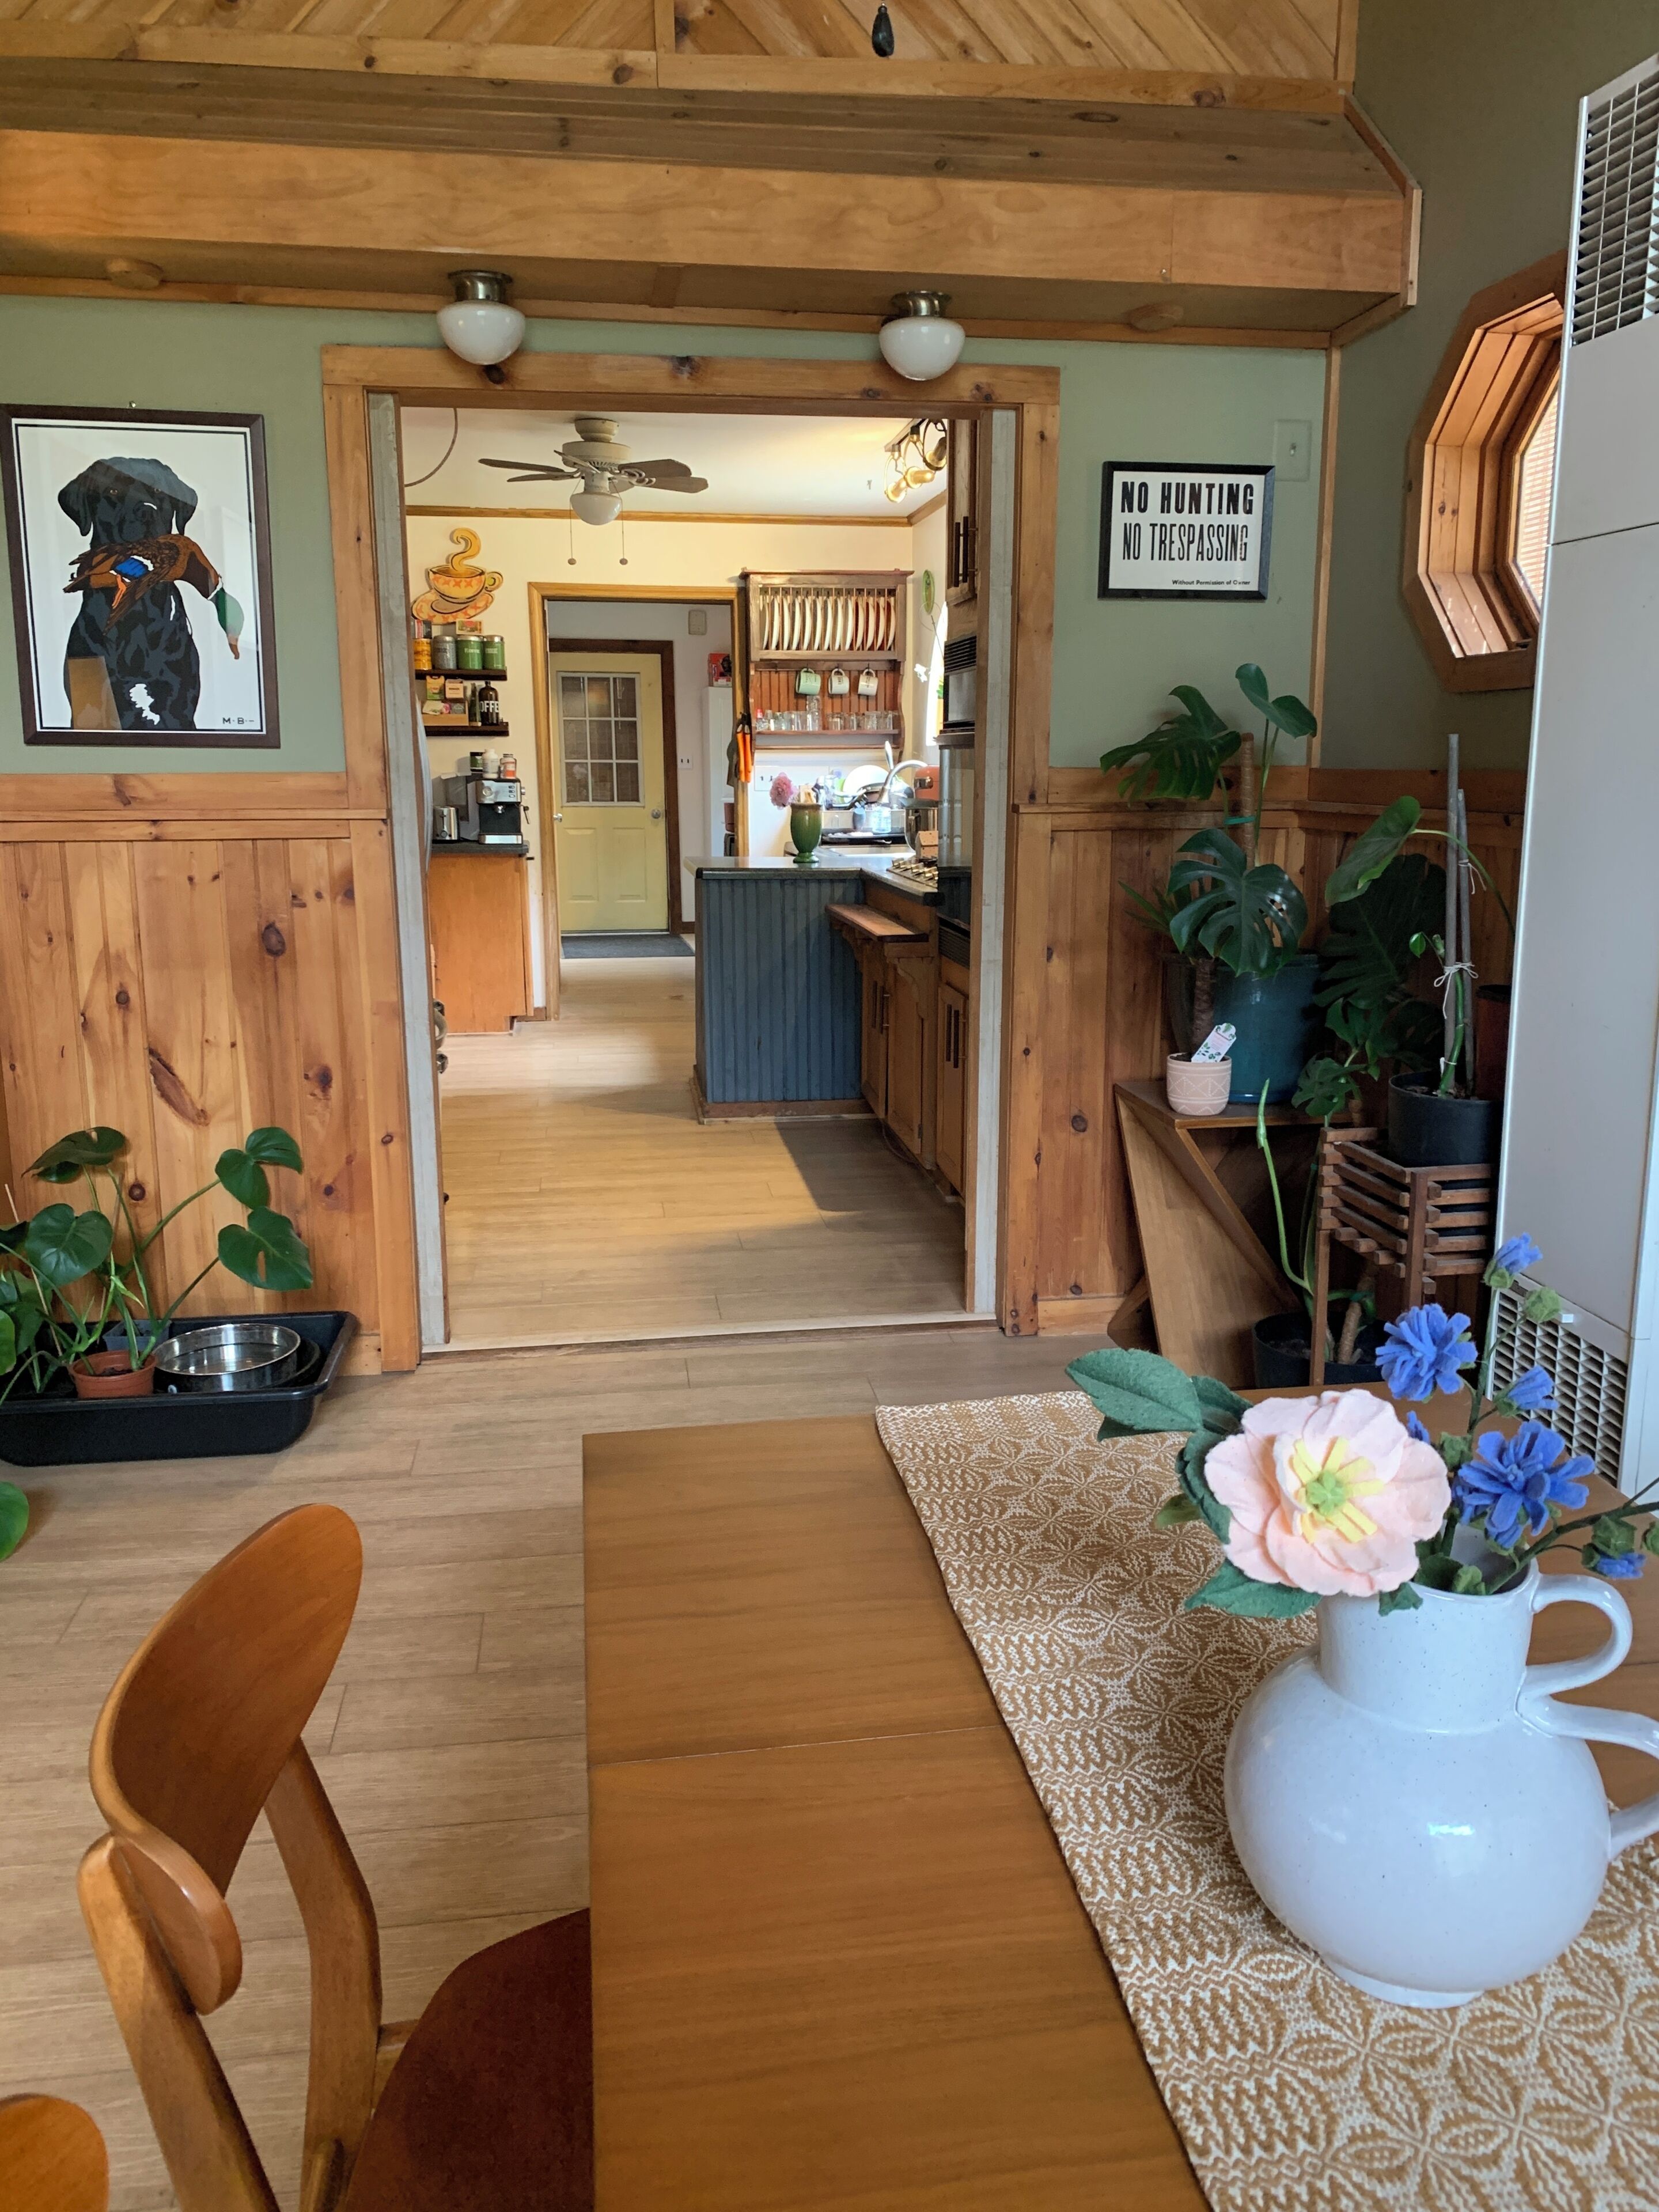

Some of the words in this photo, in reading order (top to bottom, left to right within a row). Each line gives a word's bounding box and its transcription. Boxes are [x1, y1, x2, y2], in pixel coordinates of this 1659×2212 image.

[1121, 481, 1149, 513] NO
[1160, 482, 1254, 515] HUNTING
[1123, 522, 1141, 560] NO
[1149, 522, 1248, 562] TRESPASSING
